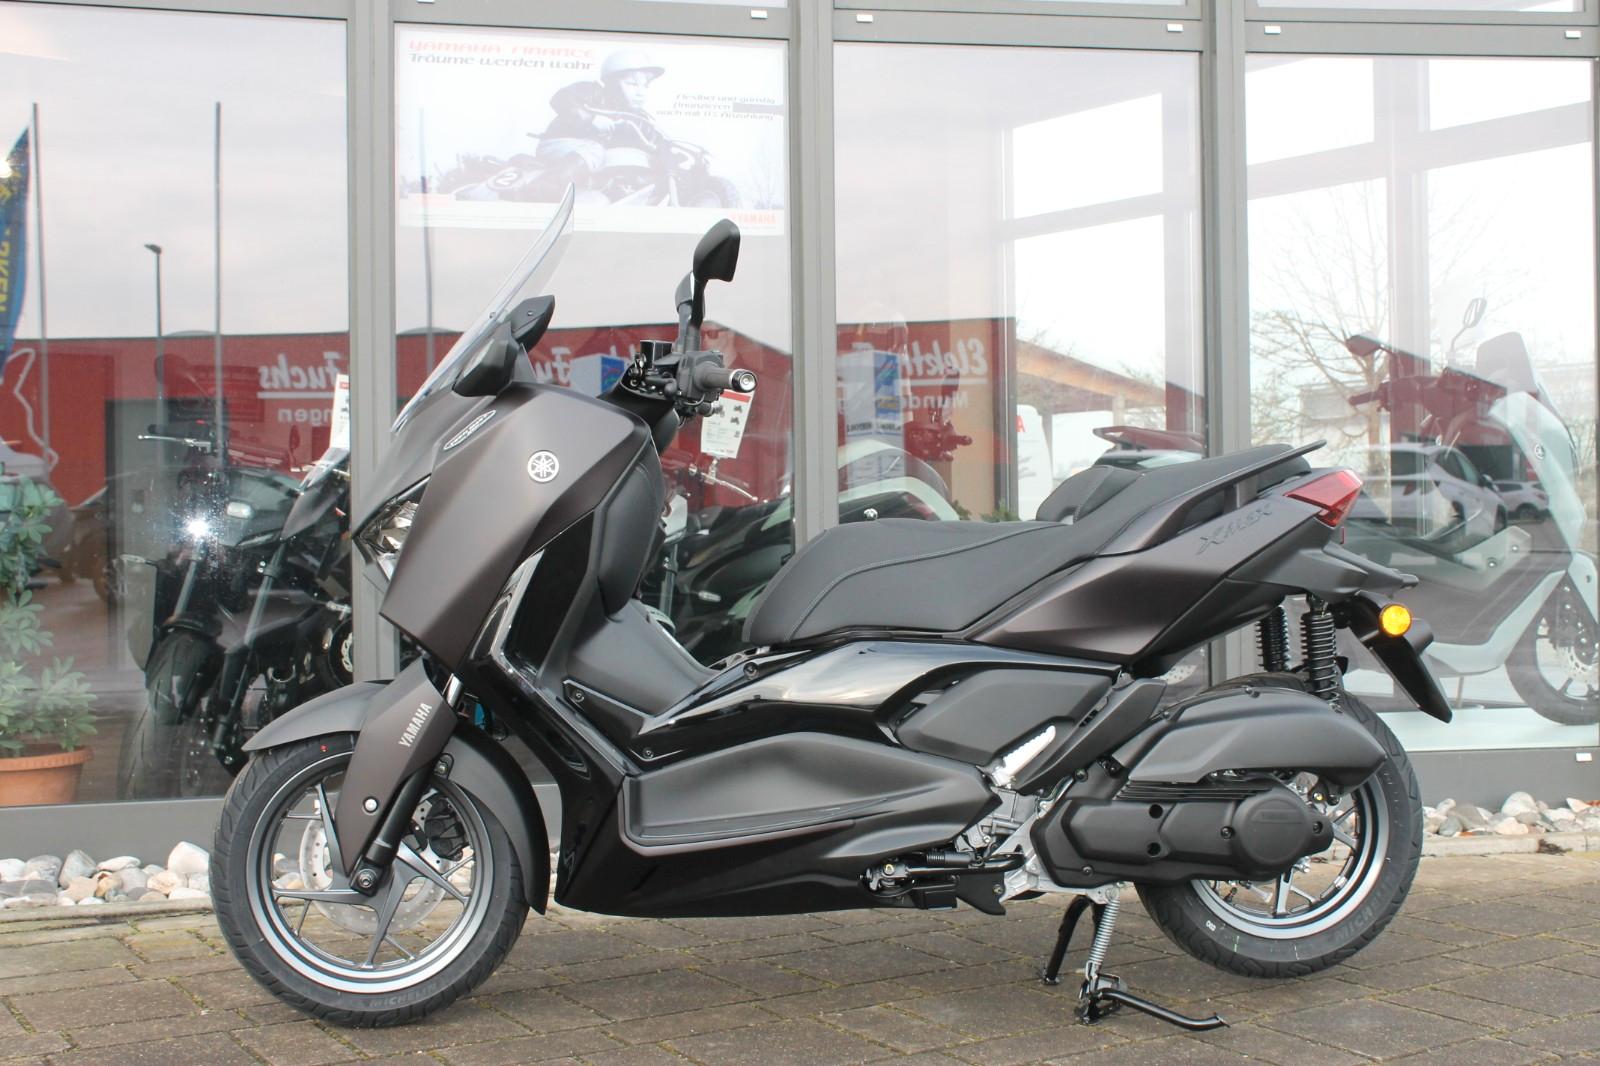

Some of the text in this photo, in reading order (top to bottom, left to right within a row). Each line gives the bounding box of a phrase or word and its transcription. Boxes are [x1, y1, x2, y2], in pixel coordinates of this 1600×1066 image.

[408, 52, 594, 71] Träume werden wahr
[737, 212, 776, 224] YAMAHA
[398, 702, 433, 748] YAMAHA
